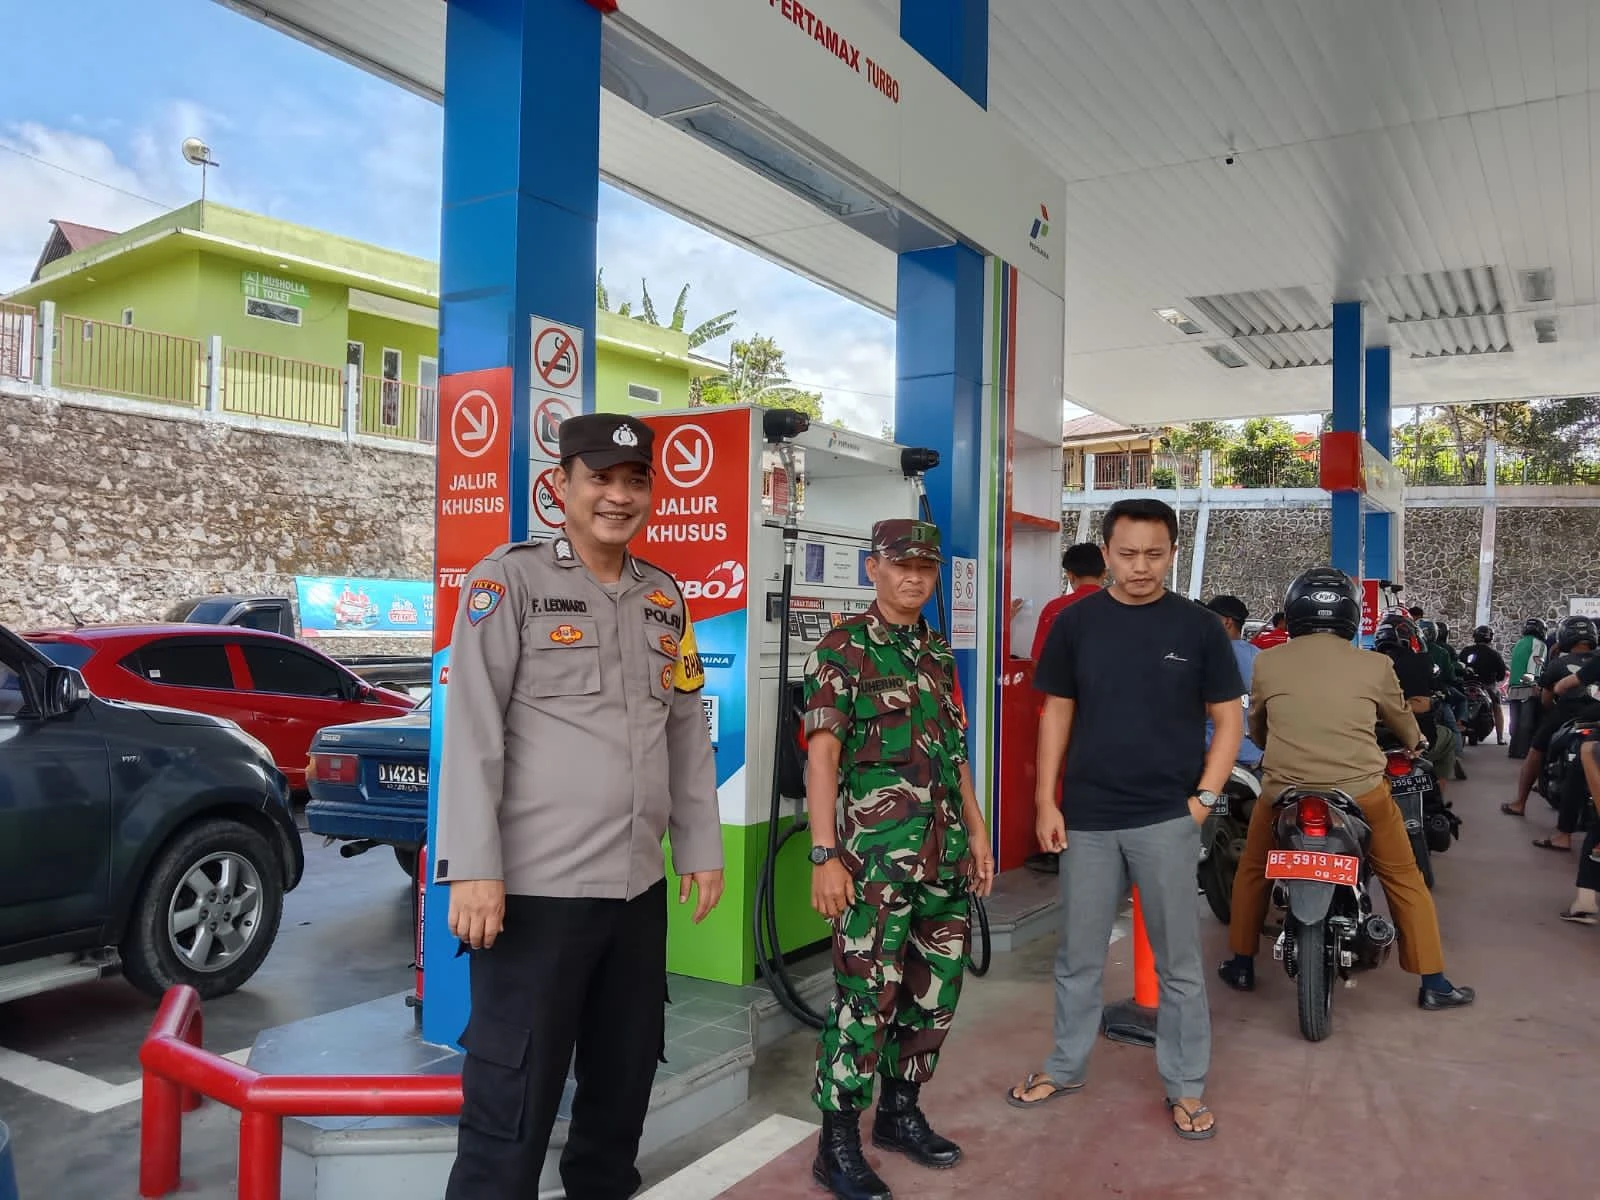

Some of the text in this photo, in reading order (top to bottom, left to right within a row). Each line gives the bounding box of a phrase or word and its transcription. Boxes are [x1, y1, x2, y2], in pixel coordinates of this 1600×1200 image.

[770, 0, 899, 103] ERTAMAX TURBO
[262, 275, 306, 294] MUSHOLLA
[263, 287, 289, 305] TOILET
[449, 472, 497, 491] JALUR
[442, 497, 505, 516] KHUSUS
[655, 496, 718, 516] JALUR
[646, 522, 728, 543] KHUSUS
[531, 598, 543, 612] F.
[643, 608, 681, 629] POLRI
[389, 765, 416, 783] 1423
[1270, 853, 1353, 870] BE 5919 MZ
